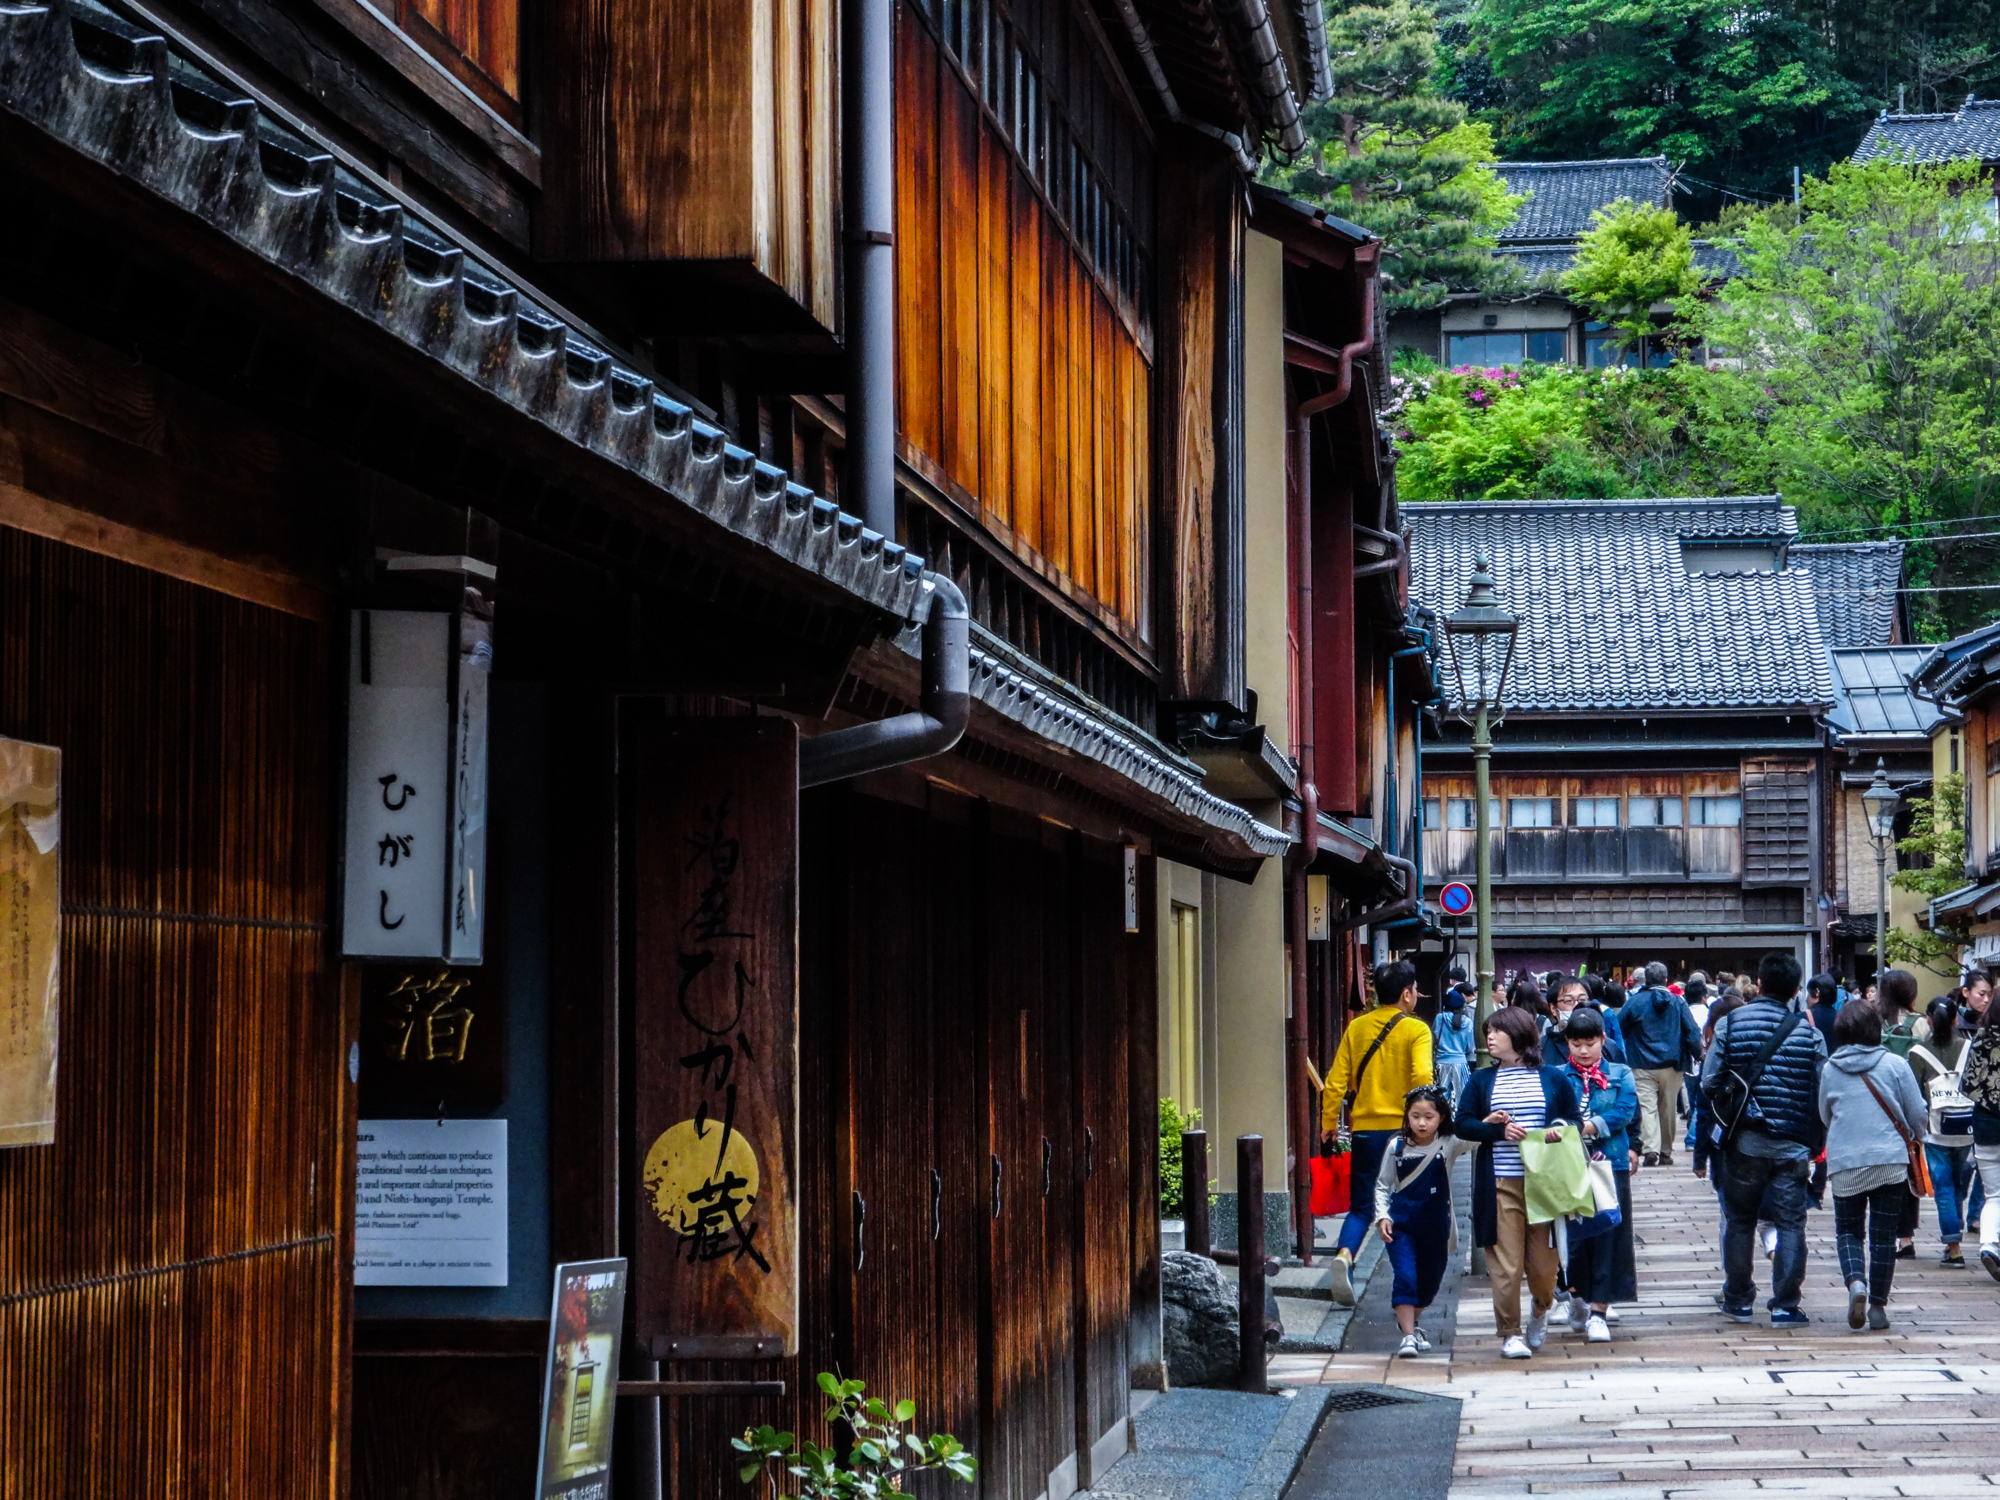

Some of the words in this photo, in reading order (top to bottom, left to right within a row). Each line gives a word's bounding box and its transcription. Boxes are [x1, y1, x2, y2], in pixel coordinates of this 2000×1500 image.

[377, 773, 416, 931] ひがし
[1313, 906, 1322, 935] ひがし
[384, 968, 475, 1065] 箔
[676, 789, 772, 1274] 箔座ひかり蔵
[1931, 1089, 1953, 1098] NEW
[381, 1150, 406, 1160] which
[408, 1151, 447, 1160] continues
[449, 1152, 458, 1160] to
[459, 1150, 493, 1162] produce
[361, 1164, 403, 1175] traditional
[404, 1164, 448, 1175] world-class
[364, 1179, 380, 1189] and
[381, 1180, 421, 1192] important
[423, 1179, 453, 1189] cultural
[454, 1180, 493, 1192] properties
[456, 1193, 494, 1207] Temple.
